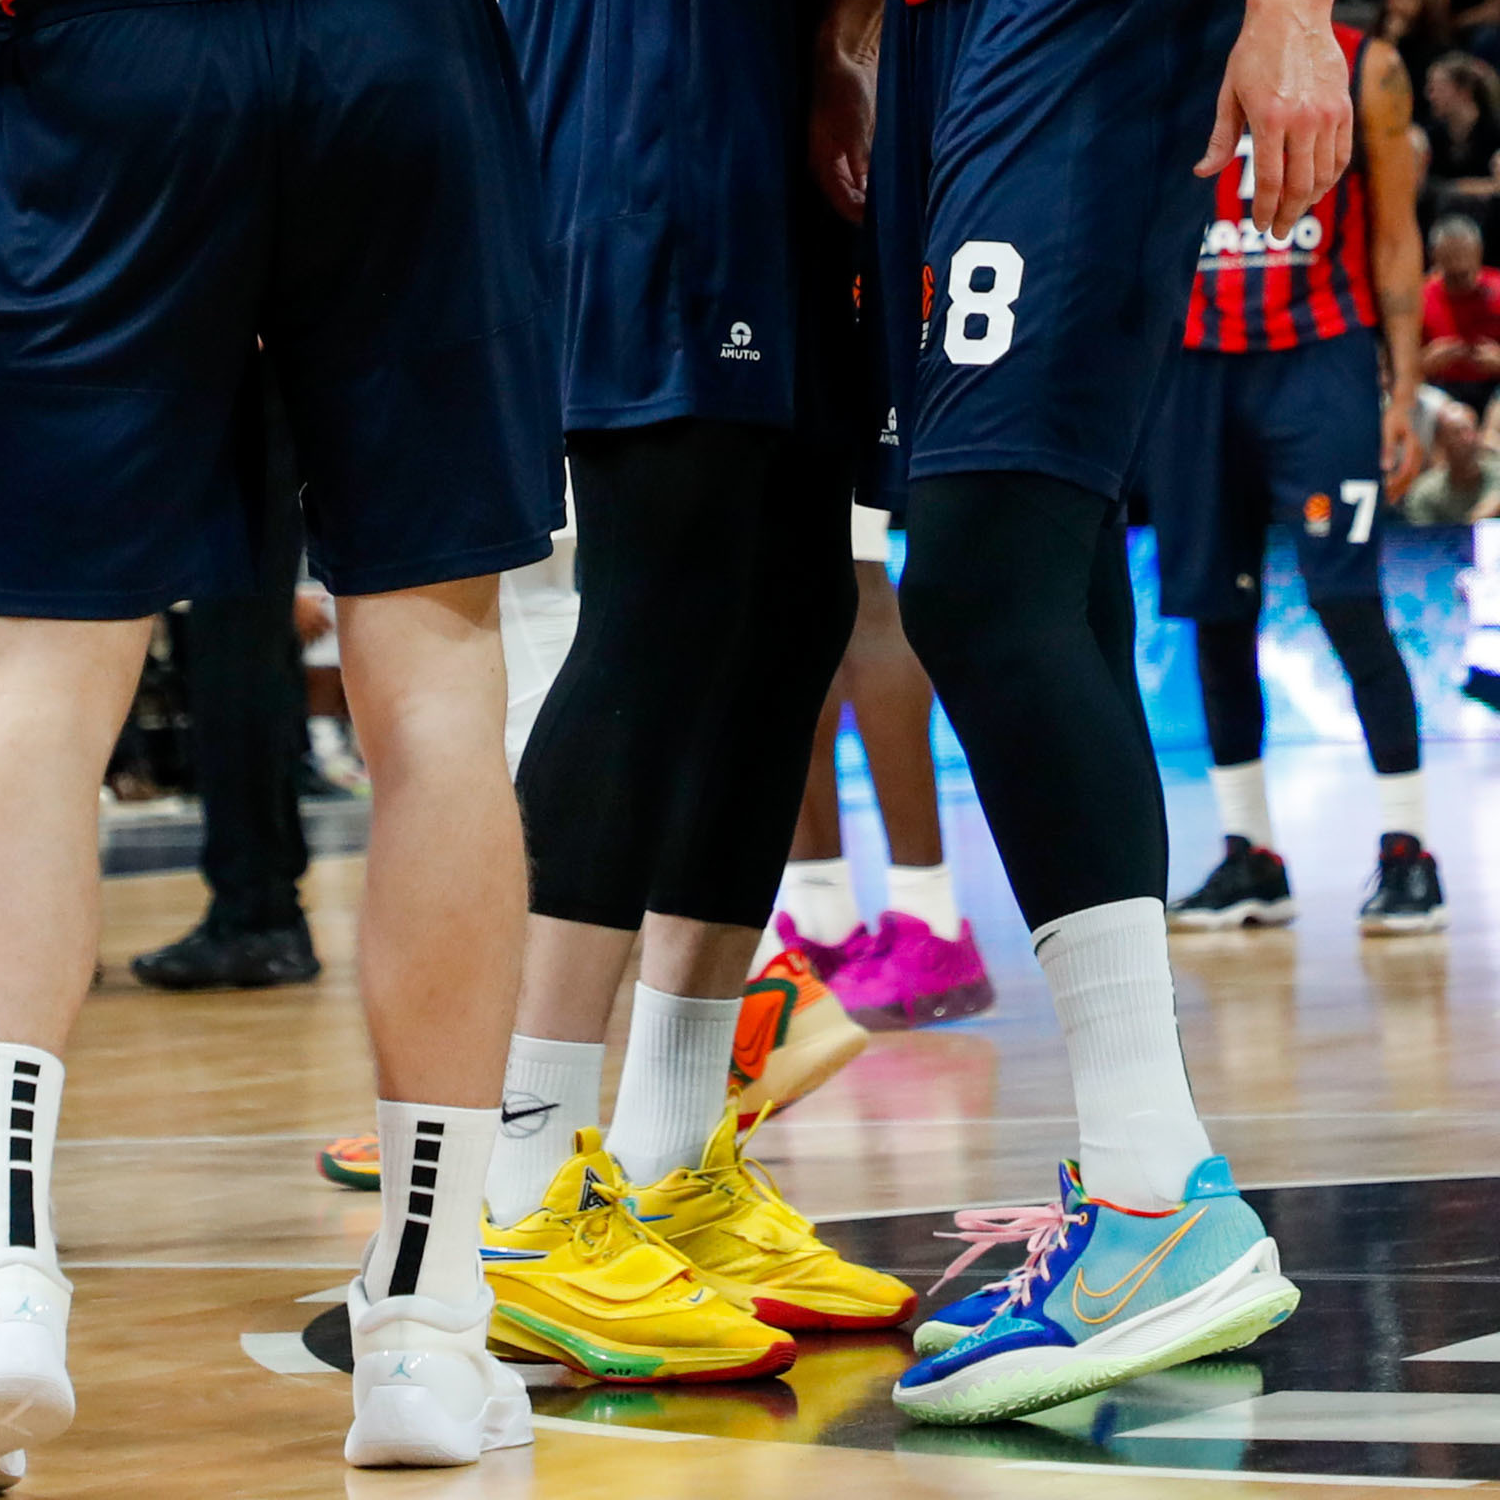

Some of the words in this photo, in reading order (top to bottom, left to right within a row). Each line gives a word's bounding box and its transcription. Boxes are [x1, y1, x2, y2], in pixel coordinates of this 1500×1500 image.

[942, 240, 1026, 367] 8
[720, 347, 762, 362] AMUTIO
[1339, 478, 1380, 544] 7
